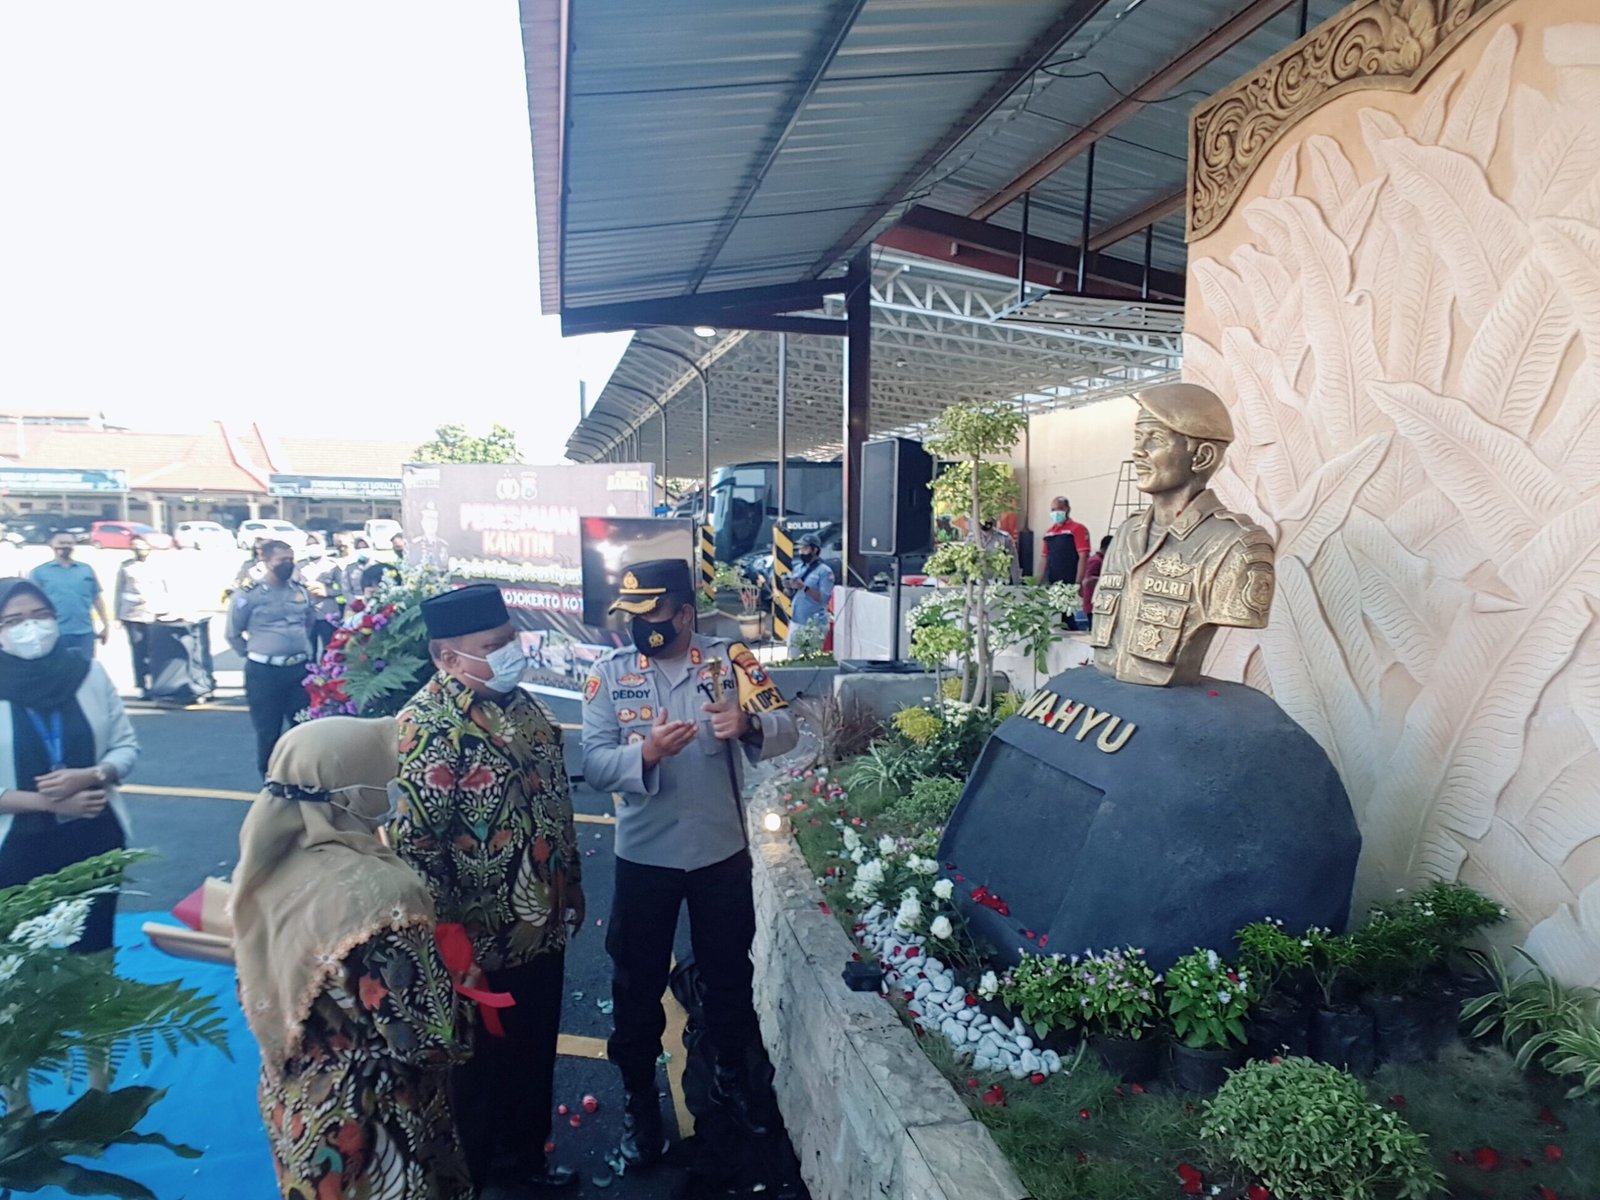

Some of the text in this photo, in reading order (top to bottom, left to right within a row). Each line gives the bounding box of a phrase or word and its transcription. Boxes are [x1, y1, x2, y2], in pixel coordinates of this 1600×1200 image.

[483, 530, 554, 558] KANTIN
[1144, 577, 1185, 596] POLRI
[612, 689, 651, 701] DEDDY
[696, 680, 735, 694] PORI
[1017, 689, 1138, 755] WAHYU
